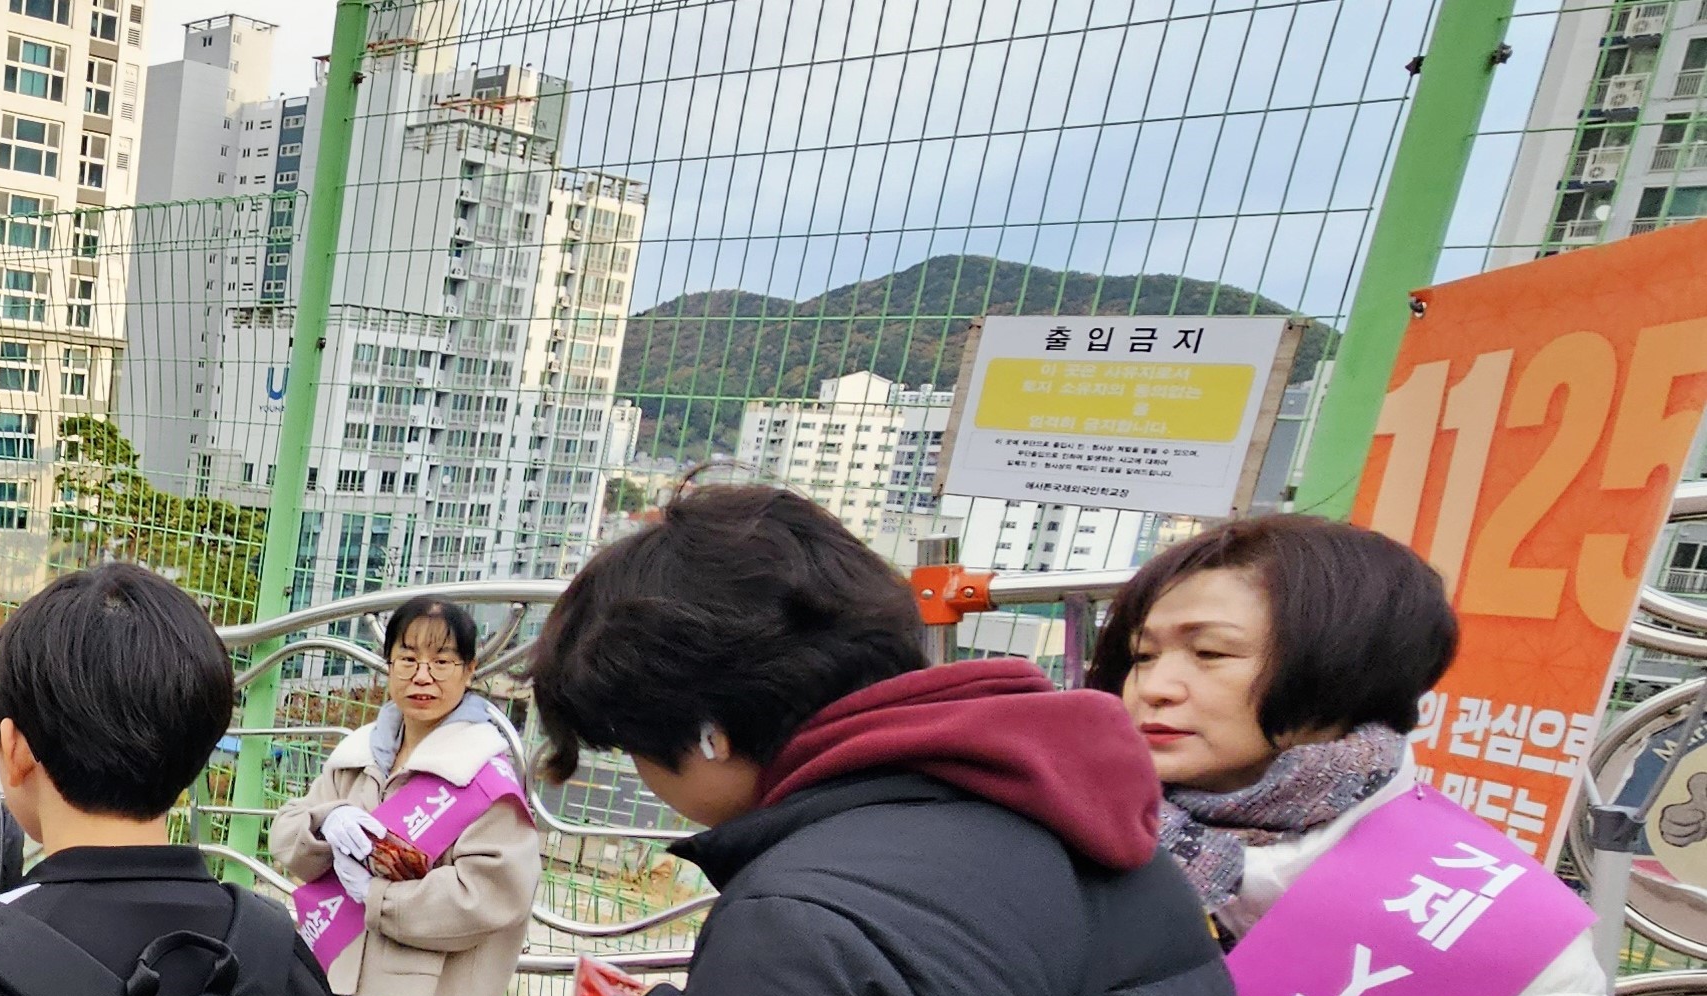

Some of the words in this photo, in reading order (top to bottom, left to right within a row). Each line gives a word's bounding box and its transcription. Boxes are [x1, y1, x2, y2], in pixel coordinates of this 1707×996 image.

[1044, 325, 1204, 353] 출입금지
[1059, 382, 1125, 397] 소유자의
[1104, 366, 1191, 381] 사유지로서
[1374, 316, 1707, 632] 1125
[1449, 696, 1594, 779] 관심으로
[403, 786, 457, 841] 거제
[1383, 842, 1528, 952] 거제
